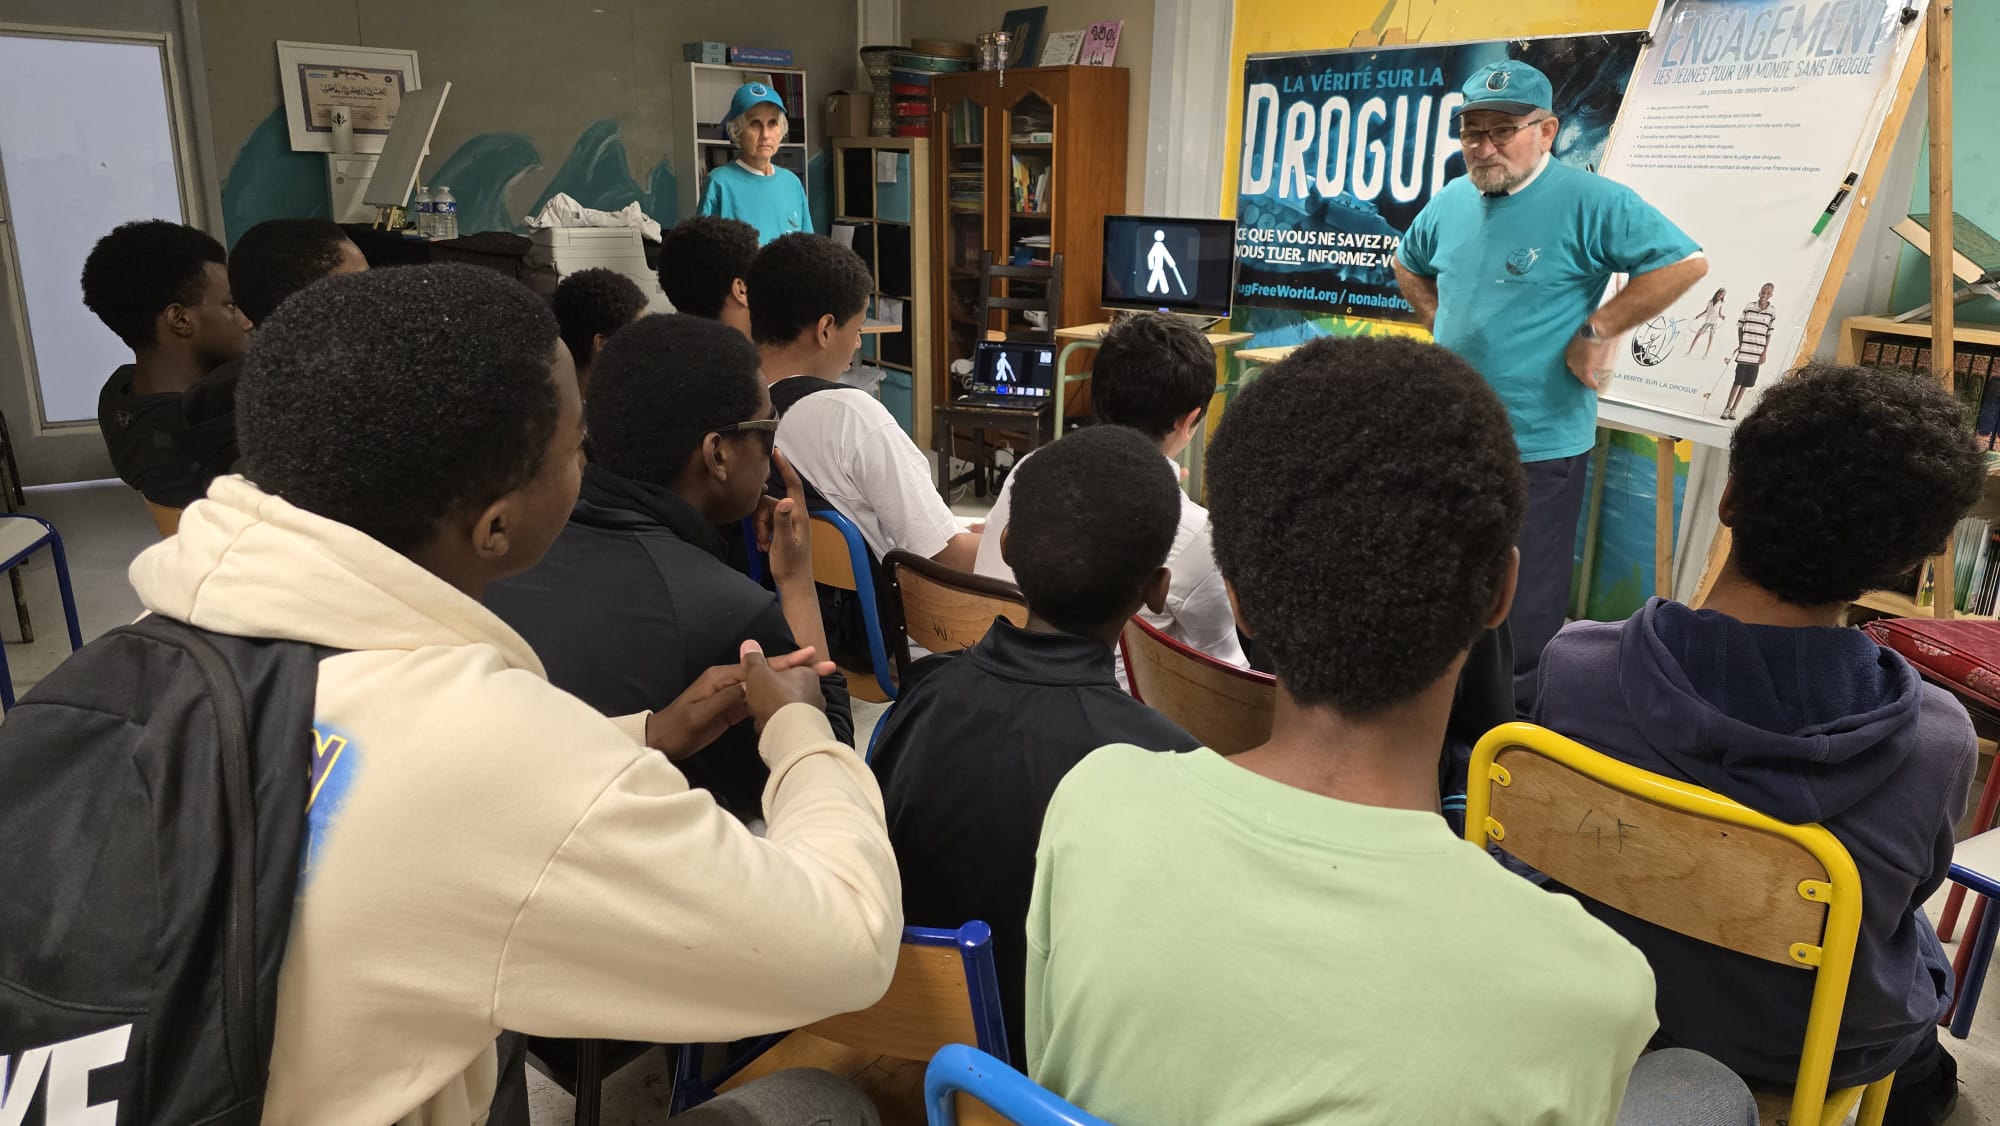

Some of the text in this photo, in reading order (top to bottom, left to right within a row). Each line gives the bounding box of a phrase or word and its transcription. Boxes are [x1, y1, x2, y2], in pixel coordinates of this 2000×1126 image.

[1661, 0, 1887, 67] ENGAGEMENT
[1283, 66, 1445, 93] LA VÉRITÉ SUR LA
[1653, 55, 1876, 85] DES JEUNES POUR UN MONDE SANS DROGUE
[1707, 87, 1733, 97] promets
[1734, 87, 1744, 95] de
[1745, 86, 1772, 94] montrer
[1781, 85, 1795, 93] voie
[1237, 228, 1401, 250] CE QUE VOUS NE SAVEZ PA
[1266, 246, 1305, 263] TUER.
[1308, 248, 1394, 268] INFORMEZ-V
[1238, 282, 1338, 305] ugFreeWorld.org
[1338, 289, 1347, 305] /
[1644, 378, 1658, 387] SUR
[1659, 381, 1668, 389] LA
[1668, 383, 1698, 395] DROGUE
